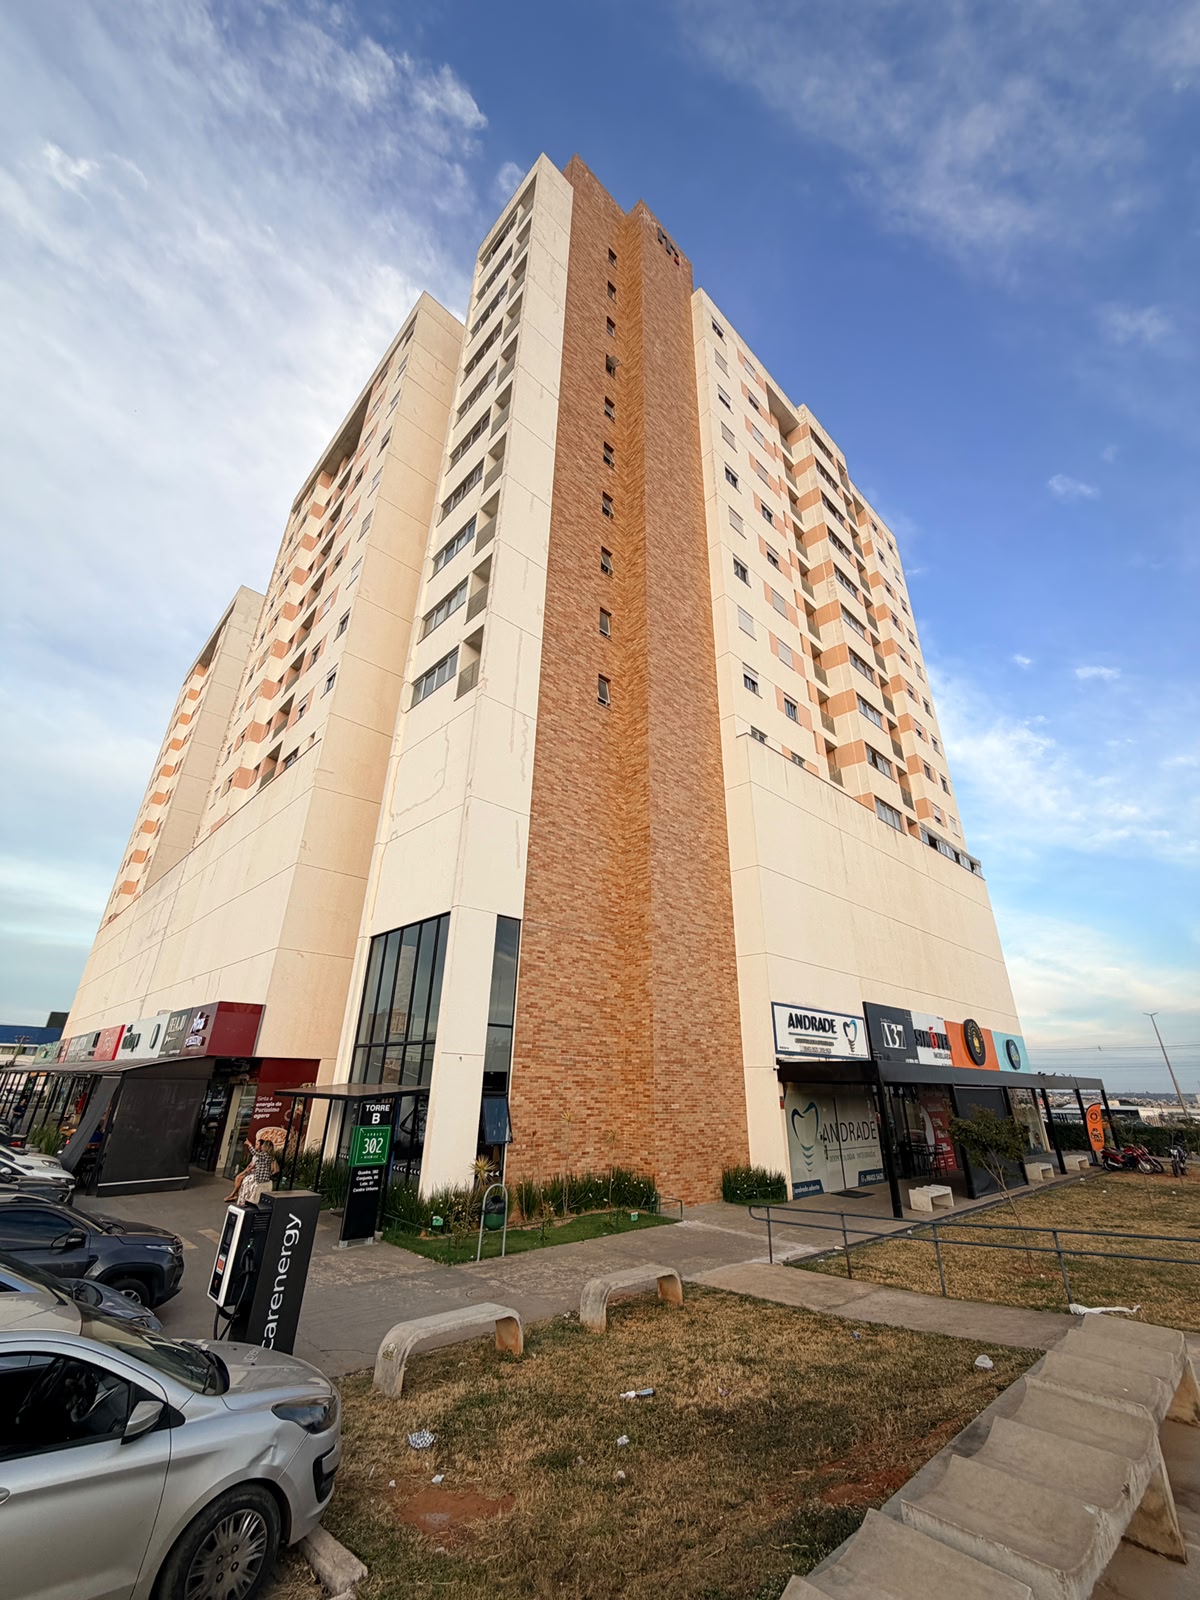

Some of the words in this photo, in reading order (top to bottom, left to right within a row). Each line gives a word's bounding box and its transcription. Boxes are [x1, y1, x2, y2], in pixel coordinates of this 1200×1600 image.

[787, 1012, 837, 1034] ANDRADE
[365, 1104, 390, 1112] TORRE
[371, 1112, 381, 1125] B
[823, 1121, 877, 1143] ANDRADE
[362, 1137, 384, 1155] 302
[261, 1213, 302, 1350] carenergy
